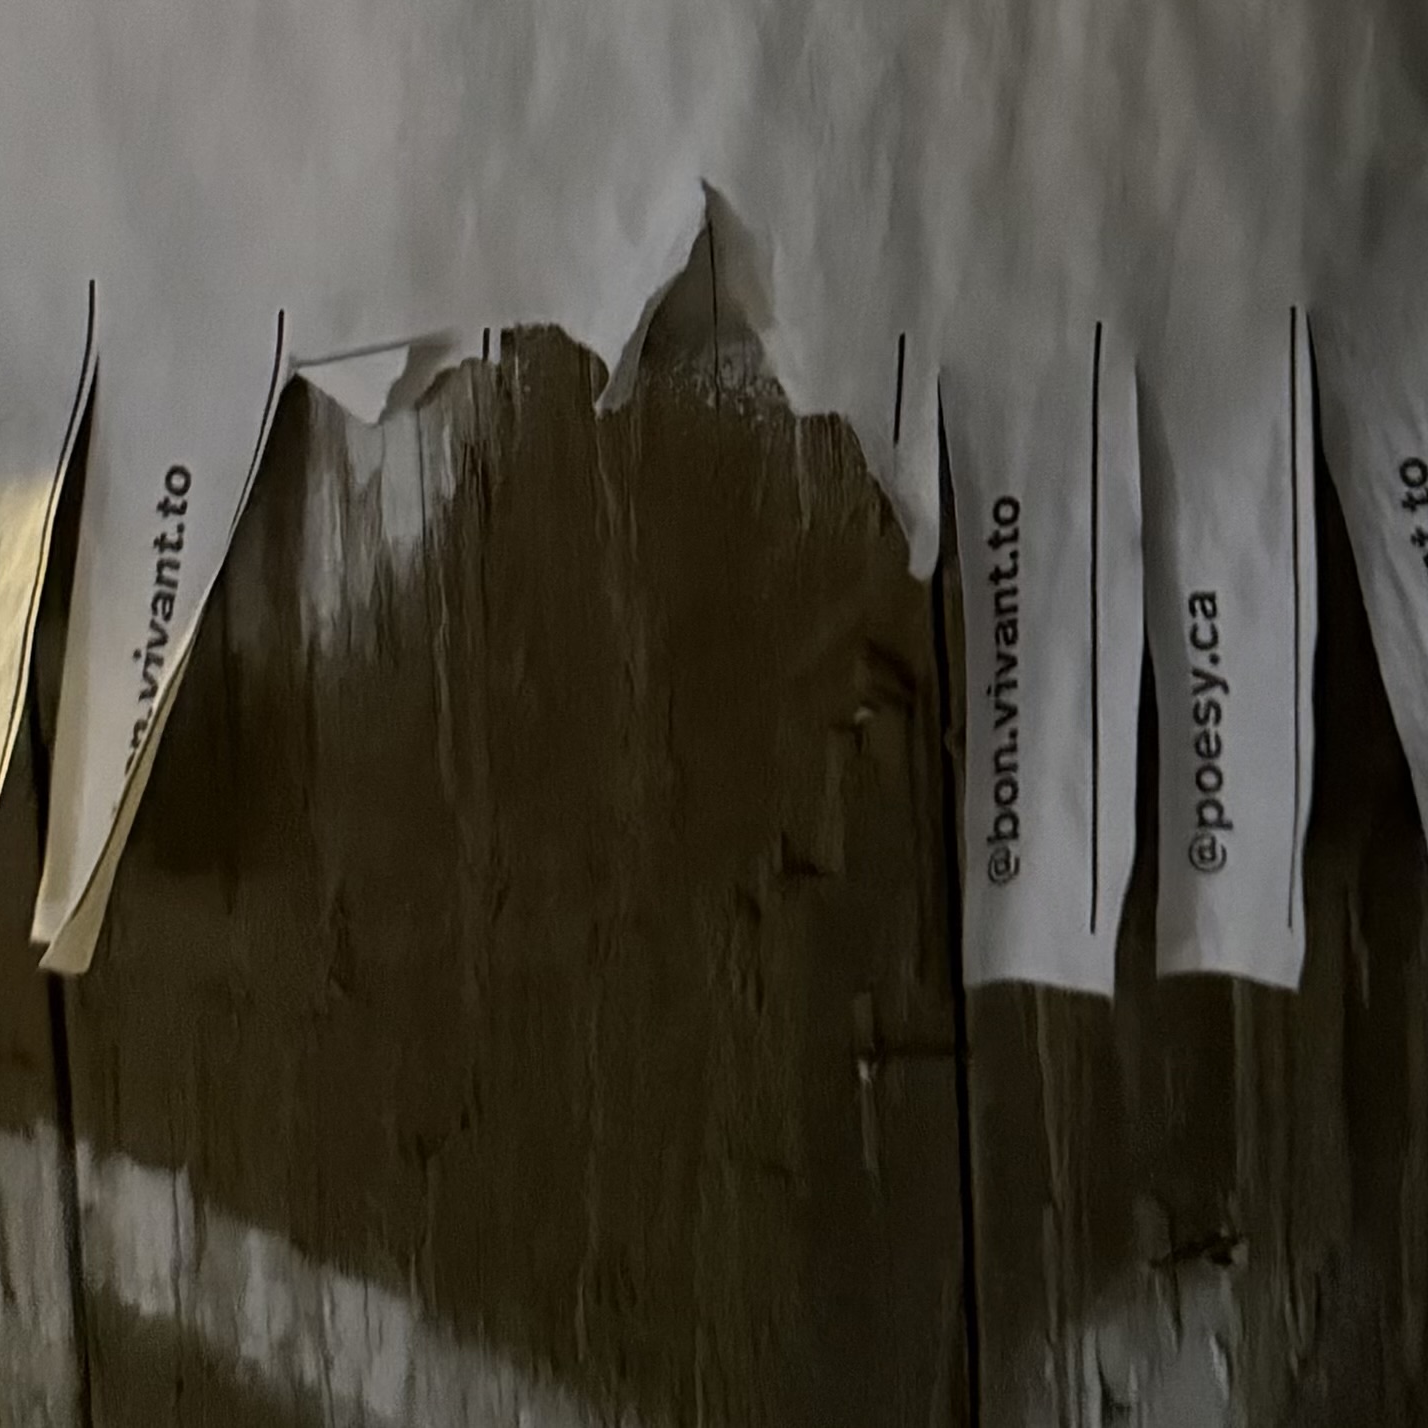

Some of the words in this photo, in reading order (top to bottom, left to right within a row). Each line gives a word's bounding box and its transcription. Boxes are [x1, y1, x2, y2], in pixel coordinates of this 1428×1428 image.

[113, 464, 193, 814] n.vivant.to
[986, 494, 1022, 888] @bon.vivant.to
[1186, 588, 1234, 875] @poesy.ca
